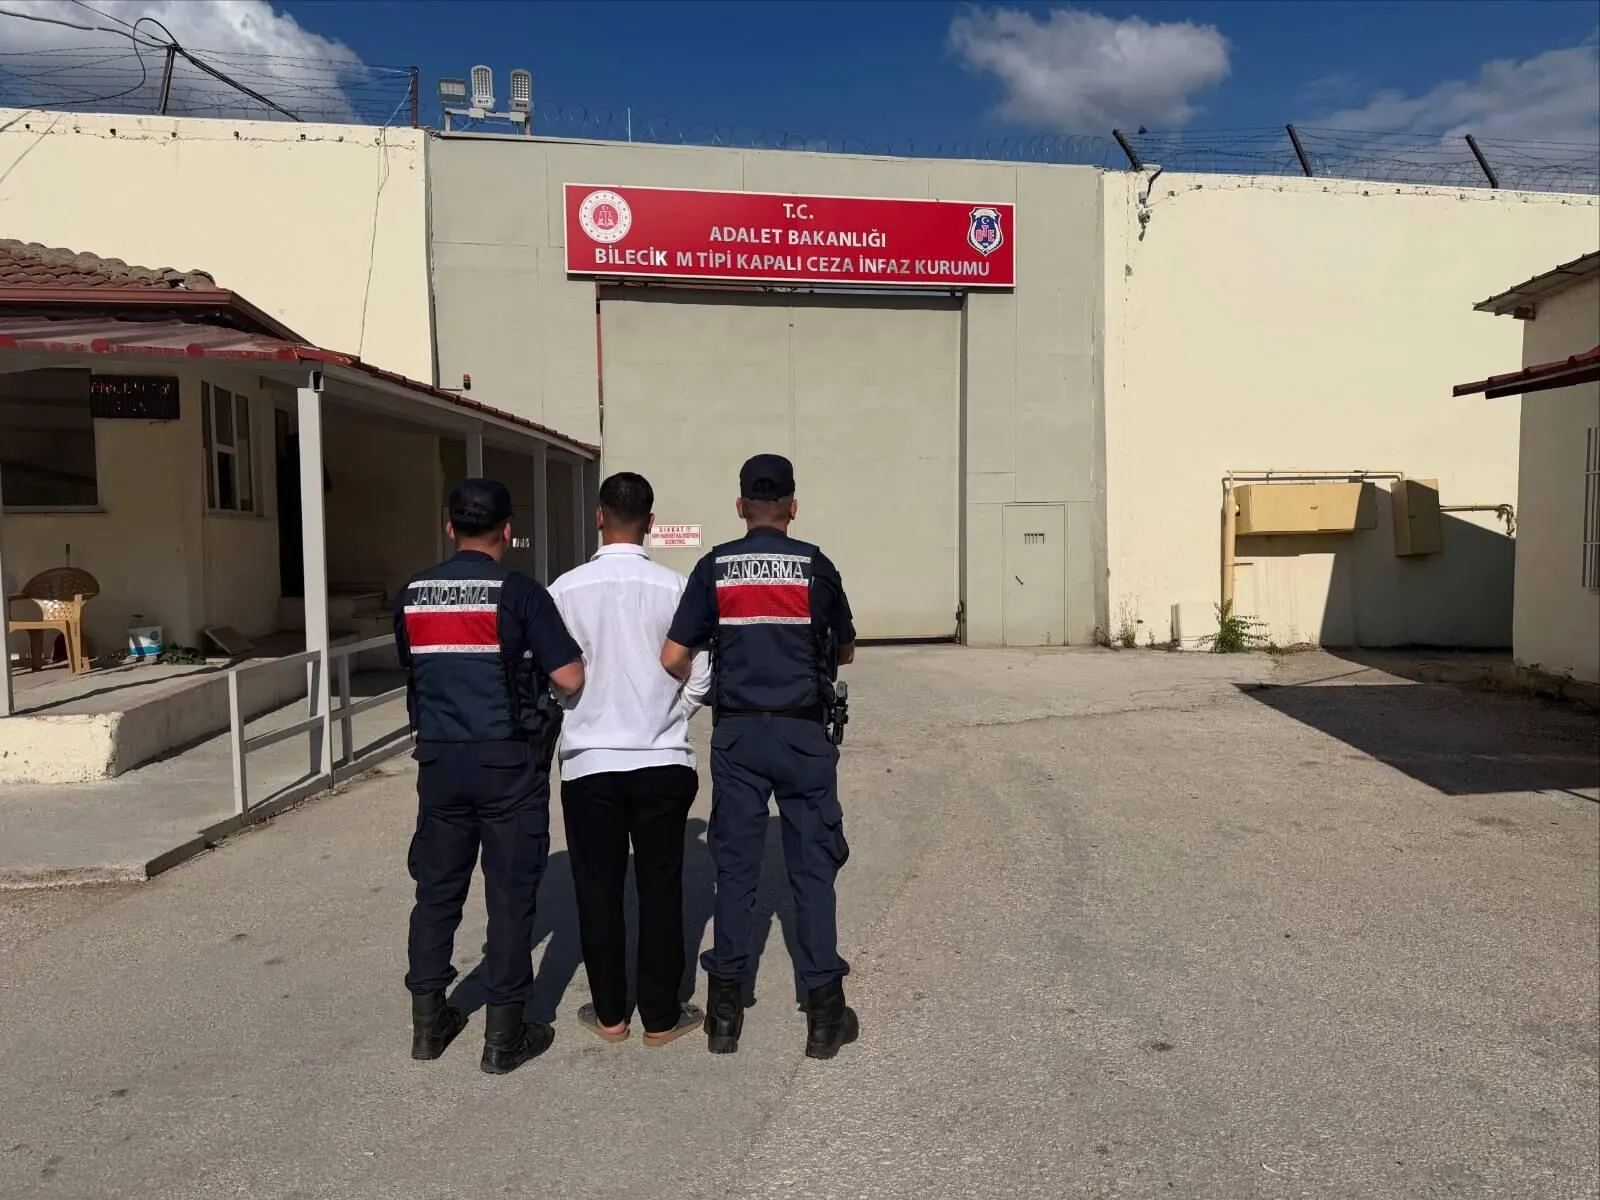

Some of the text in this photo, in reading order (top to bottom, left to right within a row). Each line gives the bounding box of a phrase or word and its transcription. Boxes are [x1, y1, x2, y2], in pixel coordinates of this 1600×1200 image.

[783, 203, 814, 219] T.C.
[709, 226, 886, 248] ADALET BAKANLIĞI
[595, 245, 990, 276] BİLECİK M TİPİ KAPALI CEZA İNFAZ KURUMU
[723, 560, 804, 580] JANDARMA
[412, 586, 488, 605] JANDARMA
